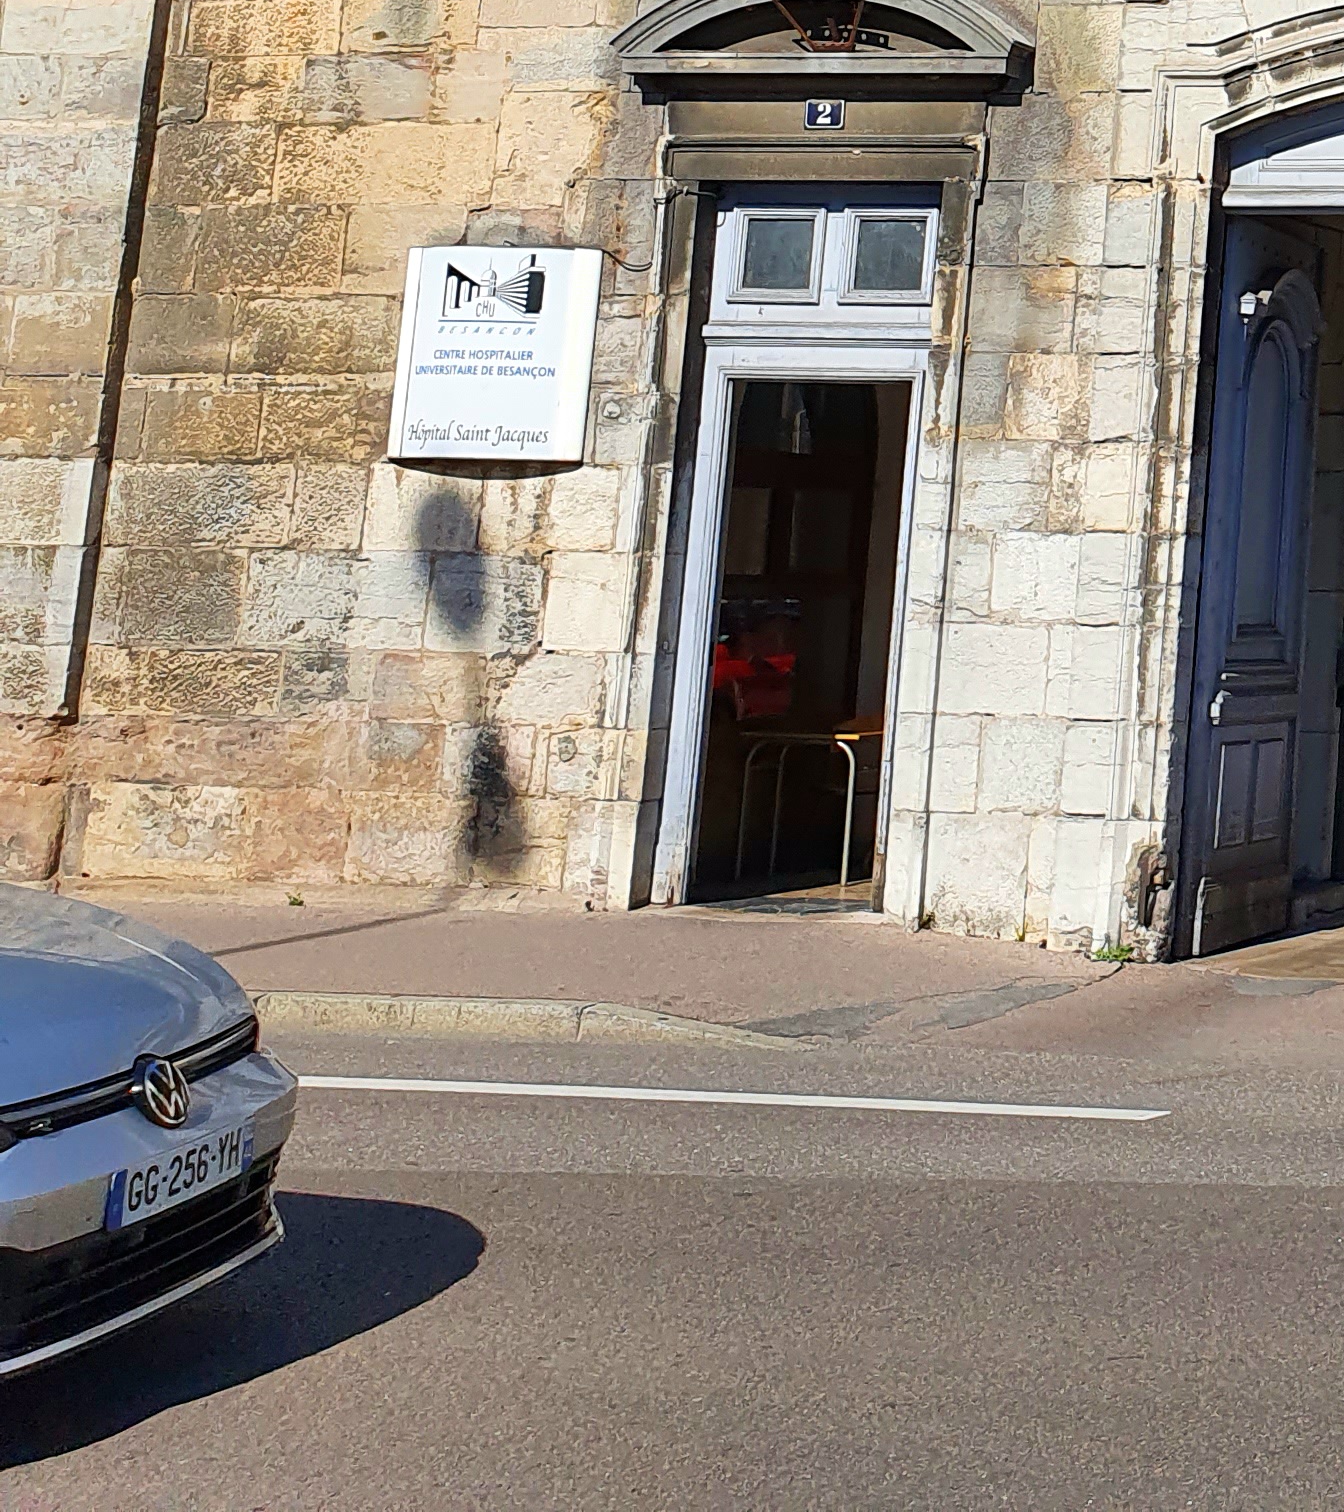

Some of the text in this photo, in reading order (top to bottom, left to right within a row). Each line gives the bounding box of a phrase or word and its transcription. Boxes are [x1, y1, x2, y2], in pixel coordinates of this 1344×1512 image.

[816, 103, 832, 124] 2
[475, 300, 496, 318] CHU
[433, 349, 533, 361] CENTRE HOSPITALIER
[415, 365, 556, 380] UNIVERSITAIRE DE BESANÇON
[408, 419, 549, 451] Hôpital Saint Jacques
[128, 1127, 243, 1212] GG-256-YH
